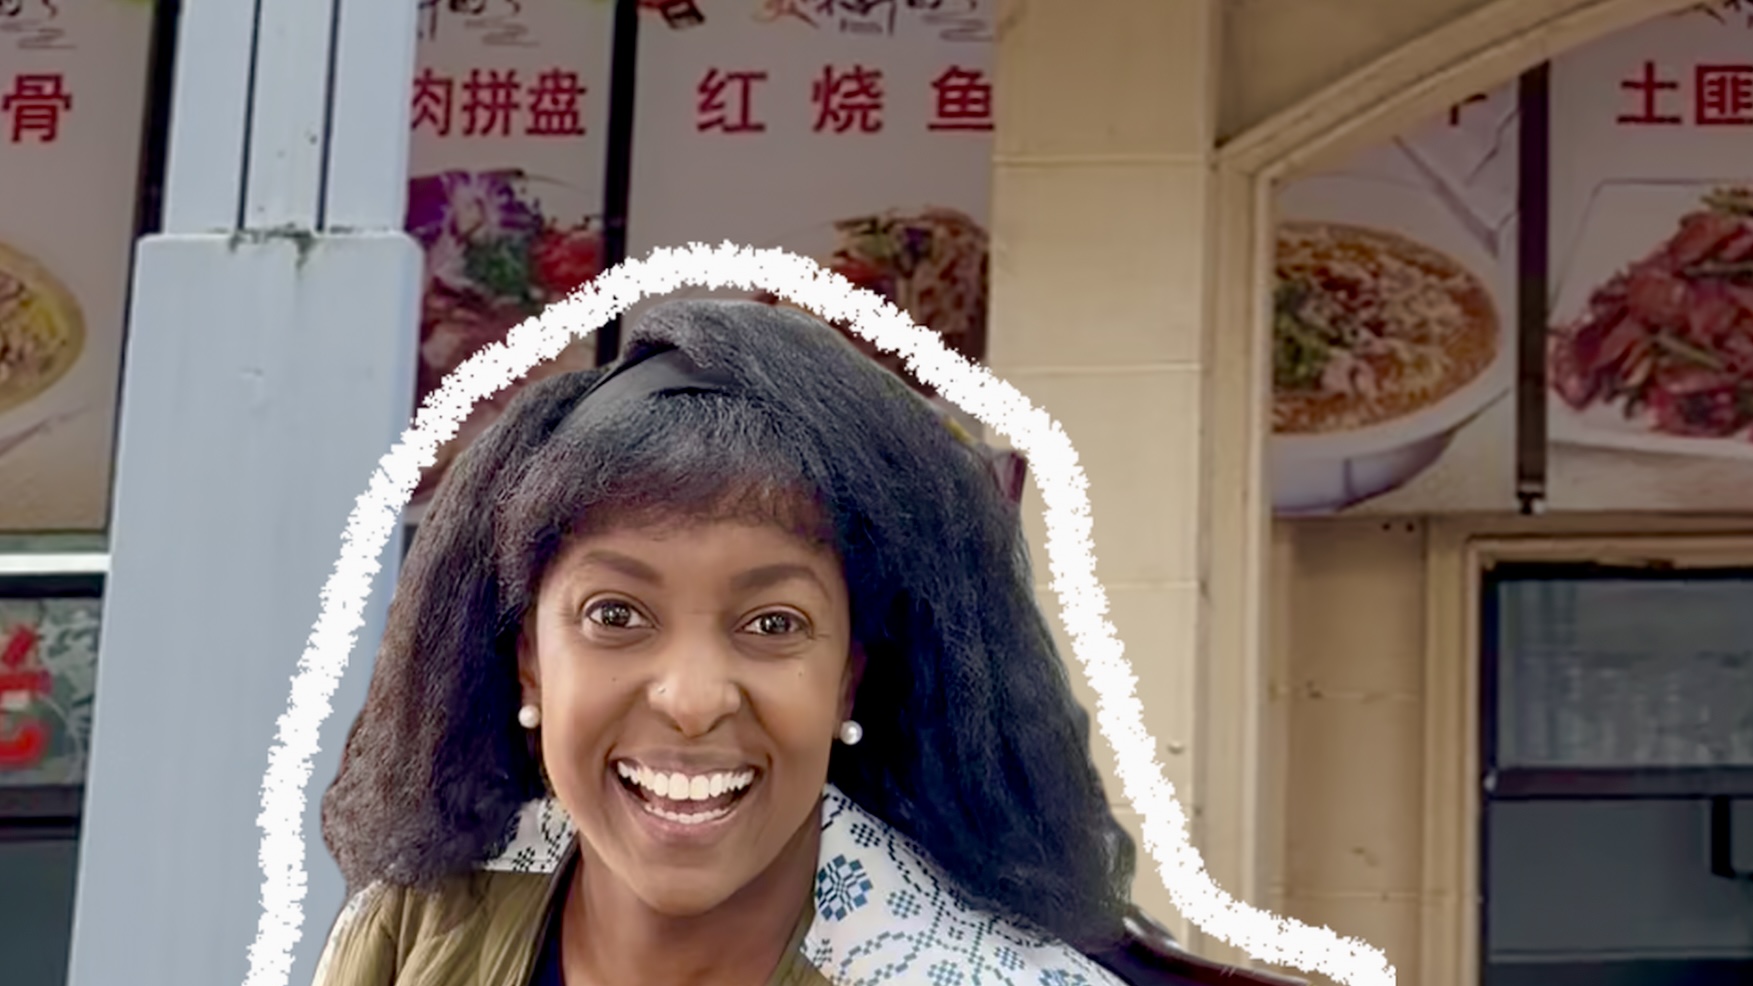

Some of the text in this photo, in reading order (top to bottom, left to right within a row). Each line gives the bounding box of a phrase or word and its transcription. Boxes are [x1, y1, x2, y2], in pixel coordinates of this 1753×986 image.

[2, 73, 73, 144] 骨
[411, 68, 588, 138] 肉拼盘
[697, 66, 995, 135] 红烧鱼
